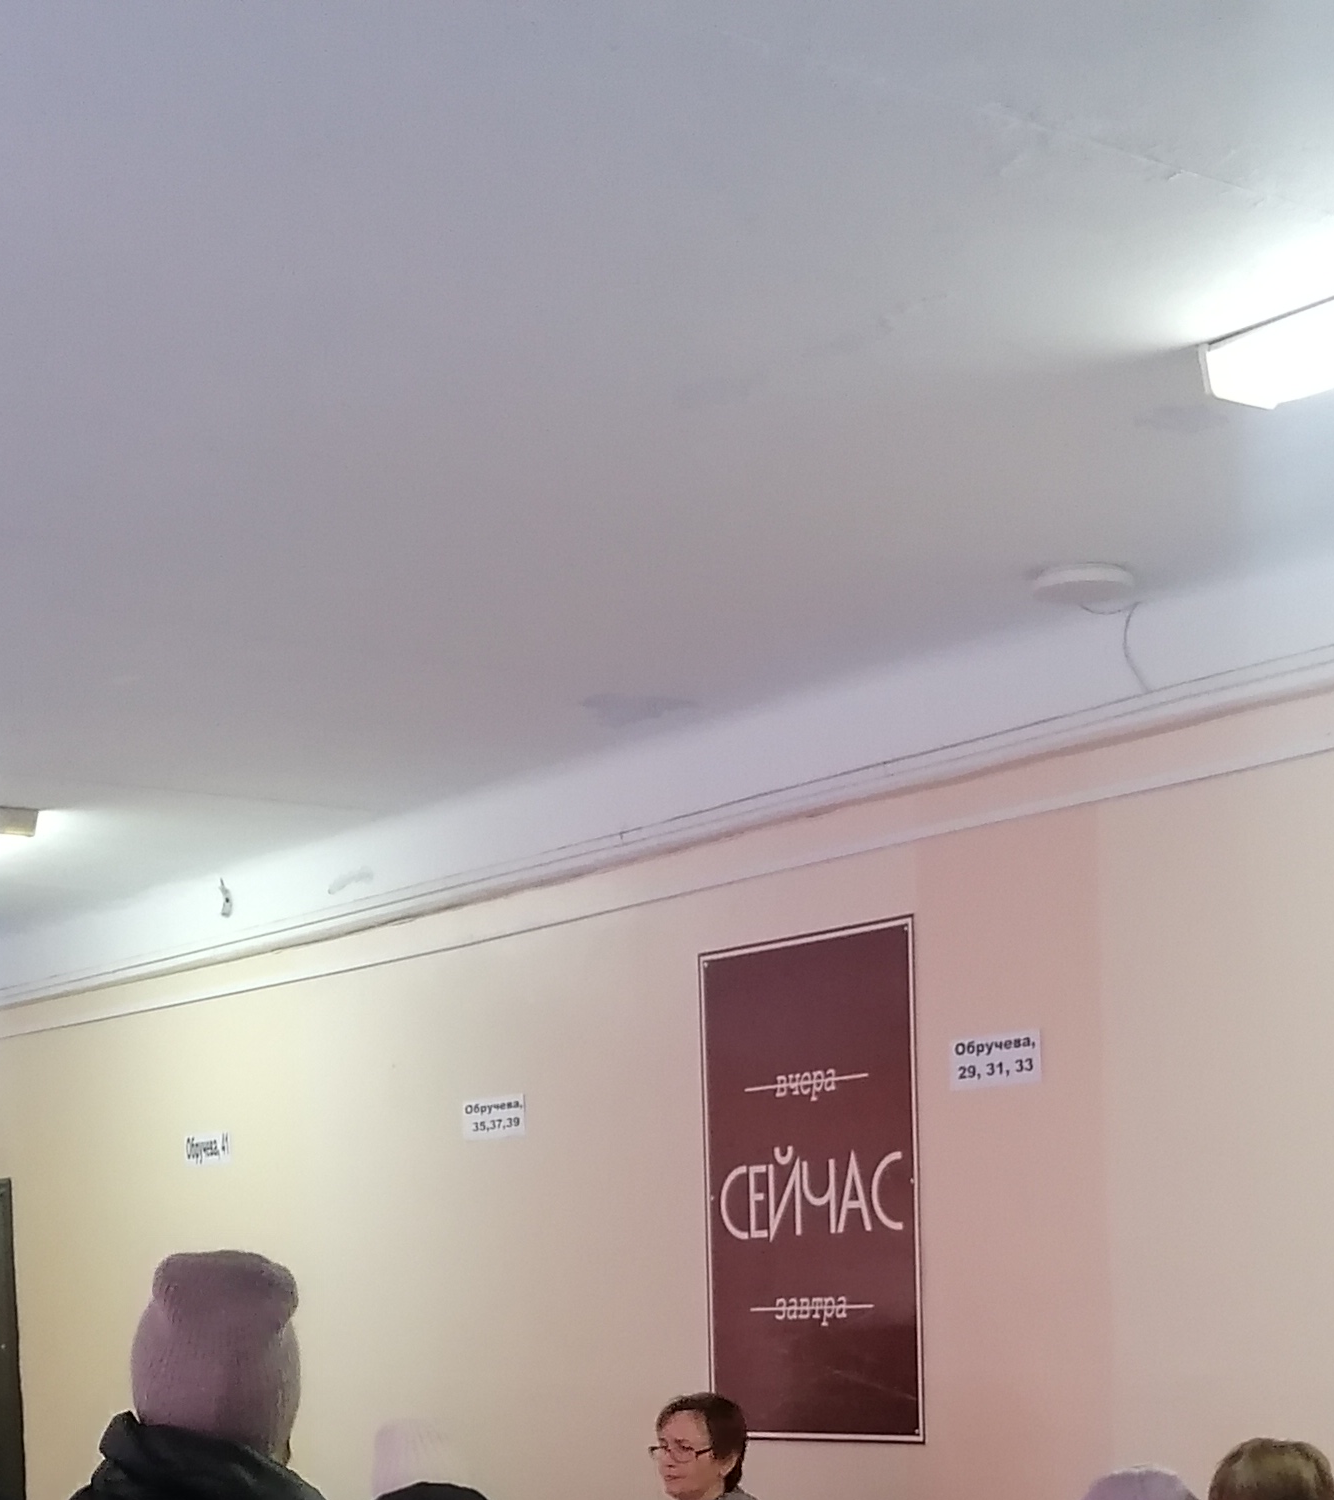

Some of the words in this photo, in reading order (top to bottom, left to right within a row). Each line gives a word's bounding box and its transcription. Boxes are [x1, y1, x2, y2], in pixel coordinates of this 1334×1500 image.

[954, 1036, 1036, 1057] Обручева,
[958, 1065, 982, 1080] 29,
[986, 1061, 1011, 1078] 31,
[1015, 1058, 1034, 1073] 33
[774, 1068, 837, 1101] вчера
[464, 1100, 523, 1116] Обручева,
[720, 1145, 905, 1243] СЕЙЧАС
[774, 1295, 848, 1327] завтра
